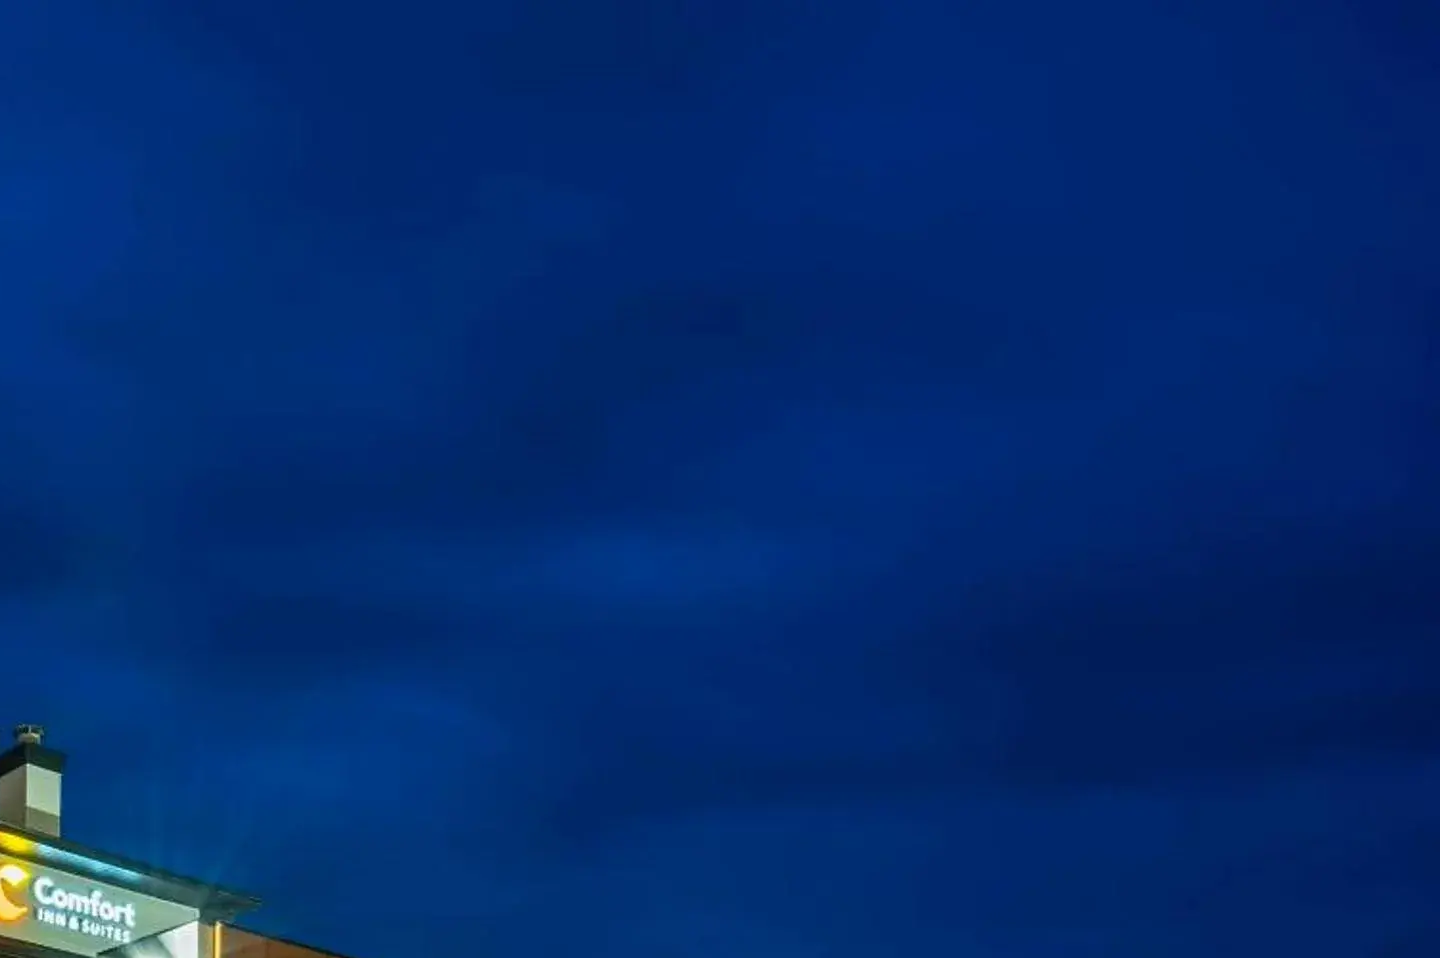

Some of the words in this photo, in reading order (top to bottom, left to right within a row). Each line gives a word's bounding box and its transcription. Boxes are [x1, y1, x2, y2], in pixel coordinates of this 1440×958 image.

[34, 877, 135, 927] Comfort
[38, 907, 66, 927] INN
[68, 915, 79, 930] &
[82, 919, 131, 943] SUITES
